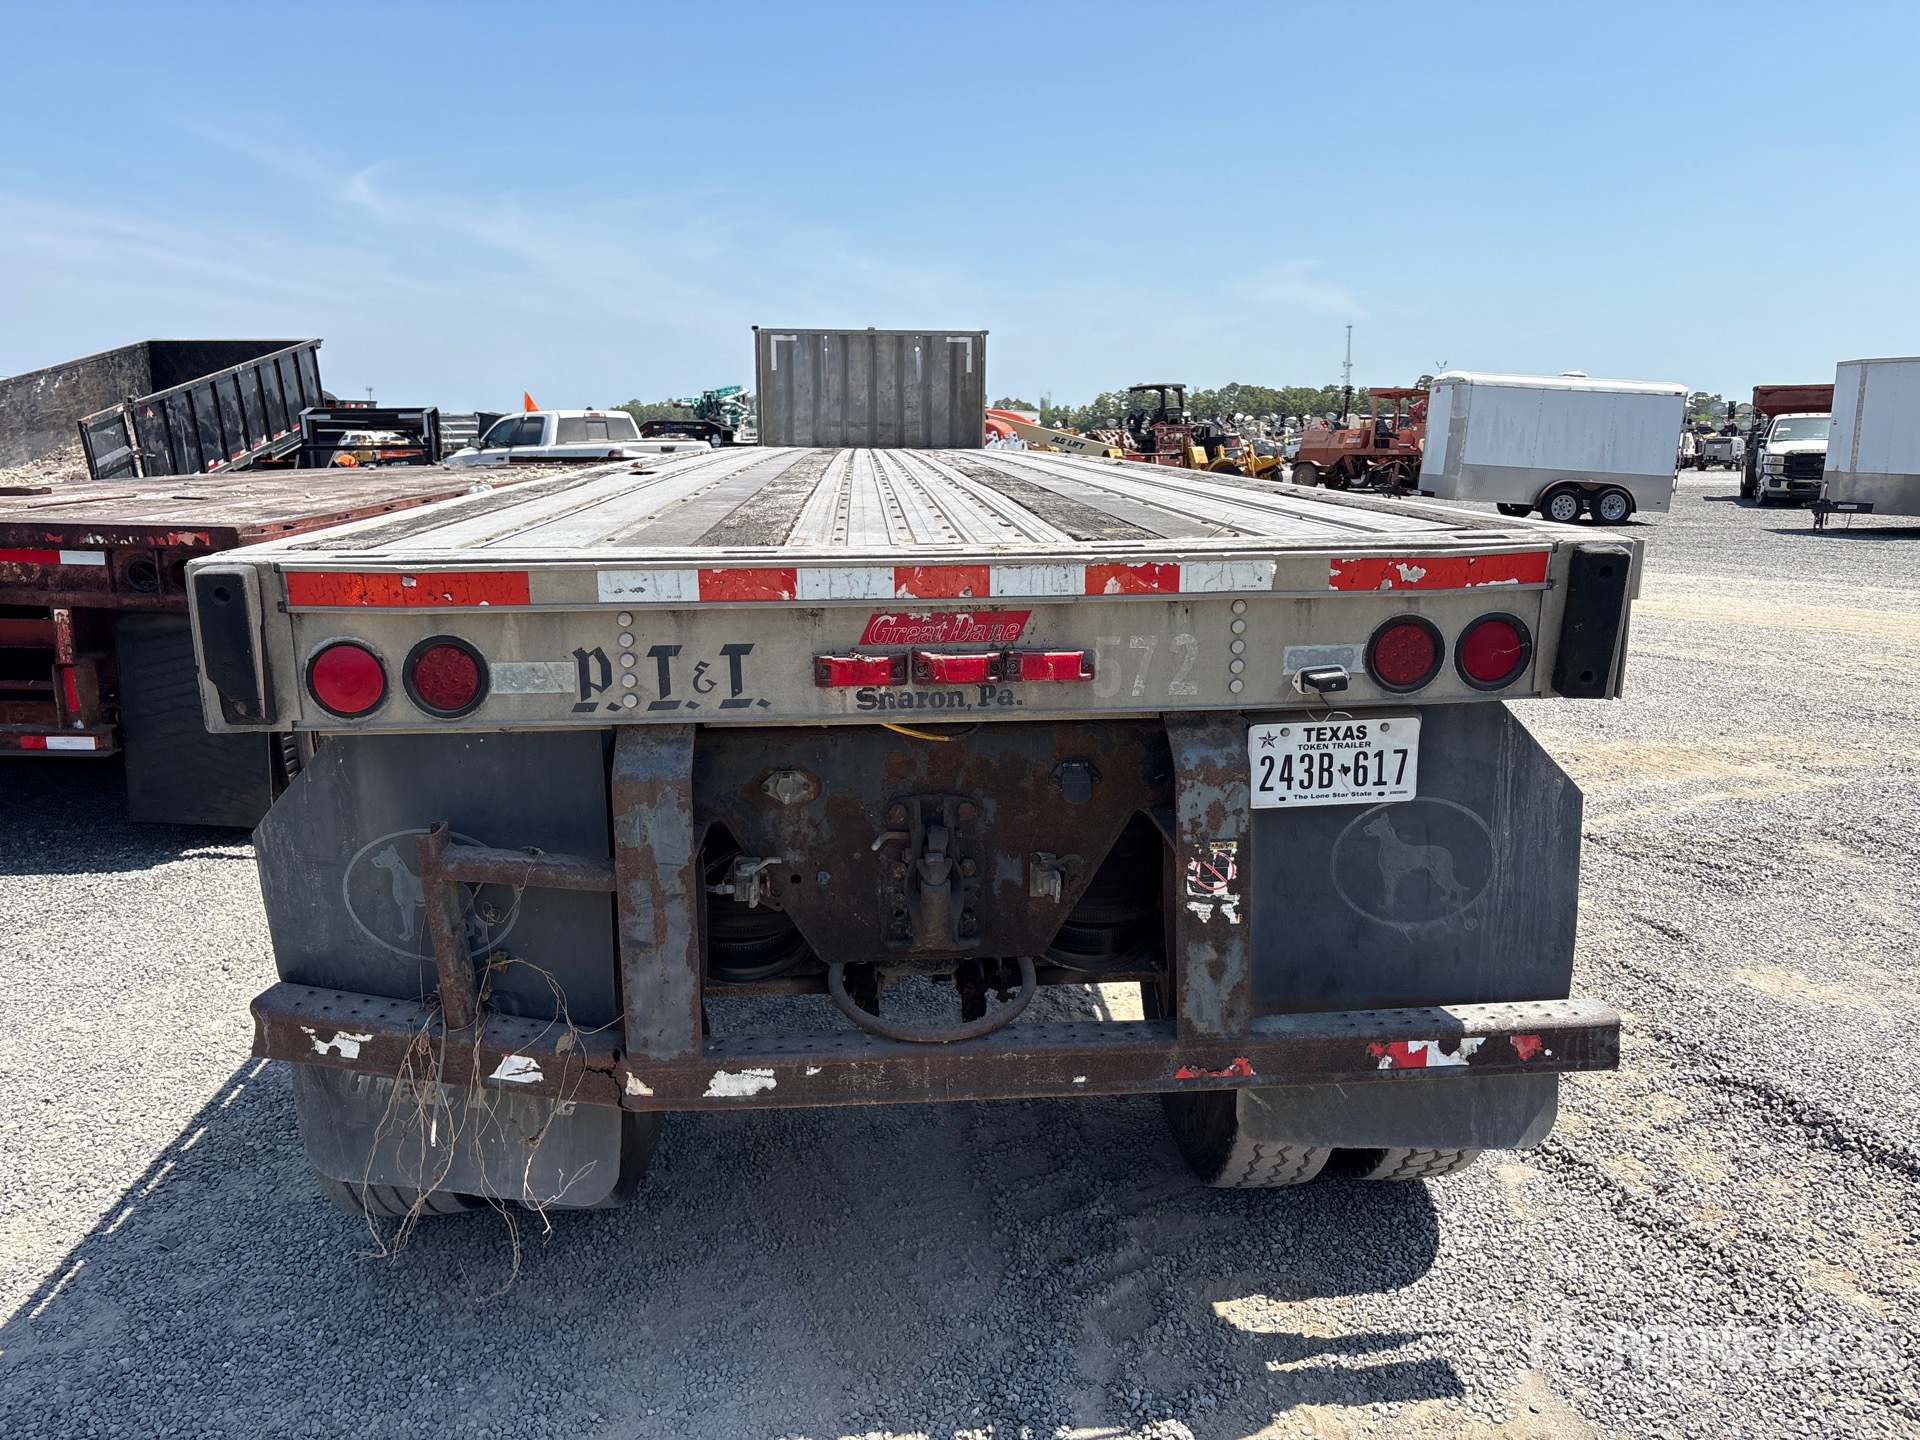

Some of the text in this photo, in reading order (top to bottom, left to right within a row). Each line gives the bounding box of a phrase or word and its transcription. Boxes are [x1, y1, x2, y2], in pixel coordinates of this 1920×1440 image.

[1051, 436, 1086, 449] JLG LIFT
[868, 613, 1021, 645] Great Dane
[1092, 633, 1199, 699] 572
[977, 684, 1023, 707] Pa.
[1303, 725, 1367, 742] TEXAS
[1298, 741, 1371, 751] TOKEN TRAILER
[1259, 749, 1408, 792] 243B 617
